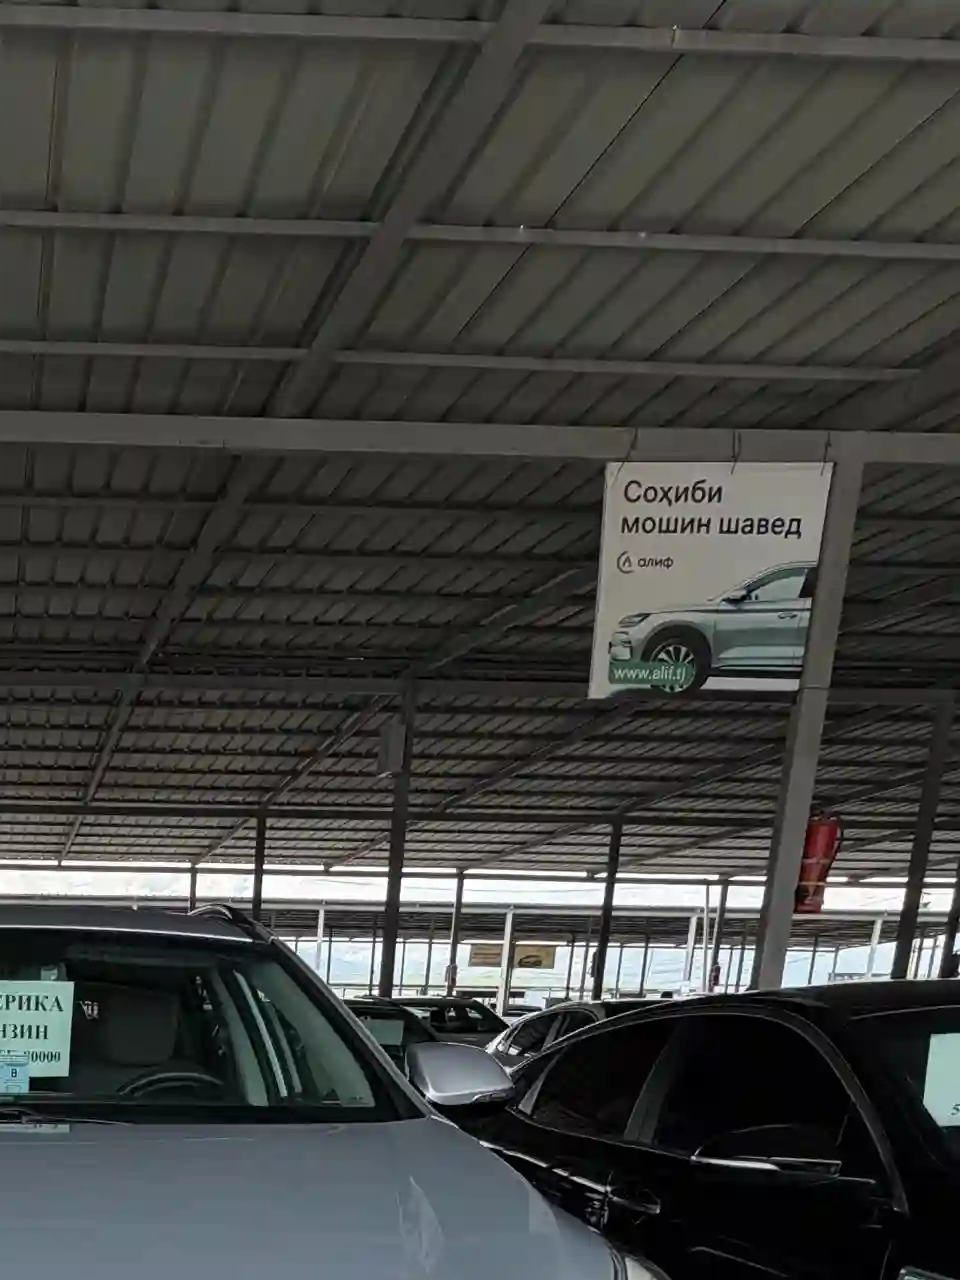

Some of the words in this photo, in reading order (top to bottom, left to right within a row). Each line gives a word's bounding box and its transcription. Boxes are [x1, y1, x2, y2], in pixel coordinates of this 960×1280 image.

[623, 479, 723, 507] Соҳиби
[621, 516, 711, 534] мошин
[718, 517, 802, 538] шавед
[637, 555, 674, 569] алиф
[613, 664, 687, 683] www.alif.tj
